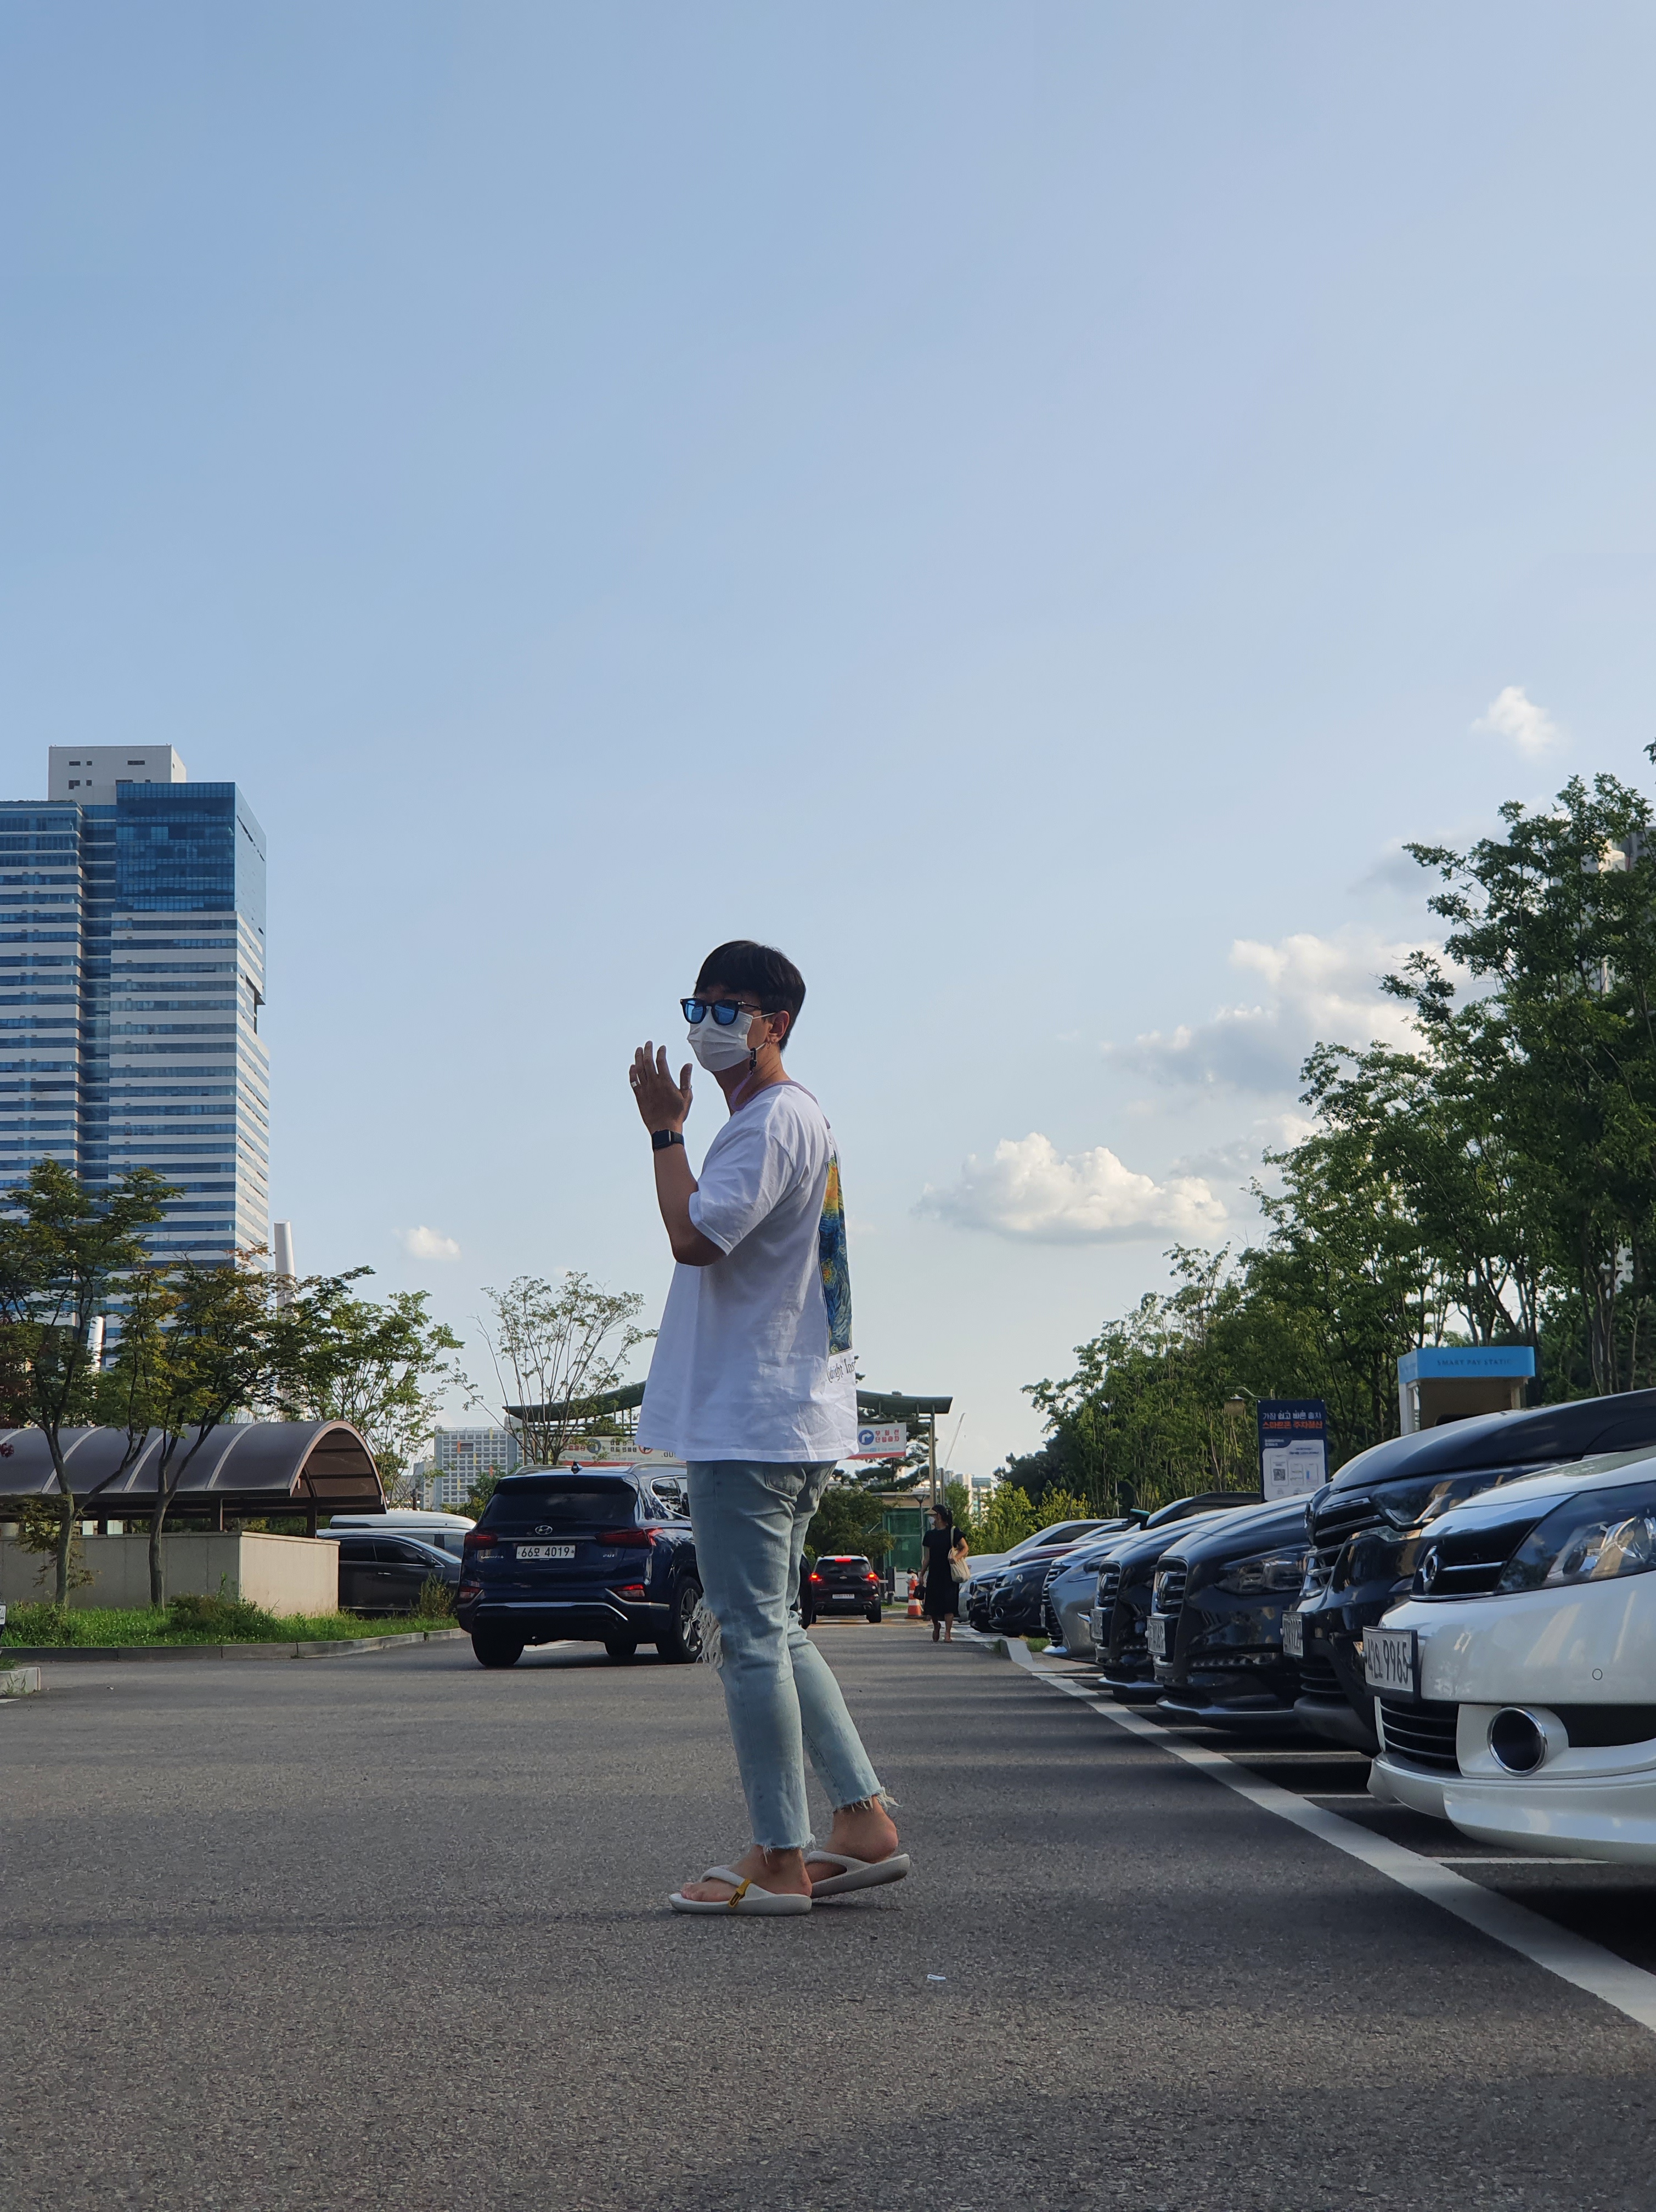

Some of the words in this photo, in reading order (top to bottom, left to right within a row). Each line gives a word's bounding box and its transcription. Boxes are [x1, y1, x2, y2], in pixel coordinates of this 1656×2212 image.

[1277, 1410, 1291, 1420] 쉽고
[1293, 1410, 1306, 1420] 빠른
[544, 1547, 570, 1557] 4019
[1383, 1639, 1409, 1684] 9965
